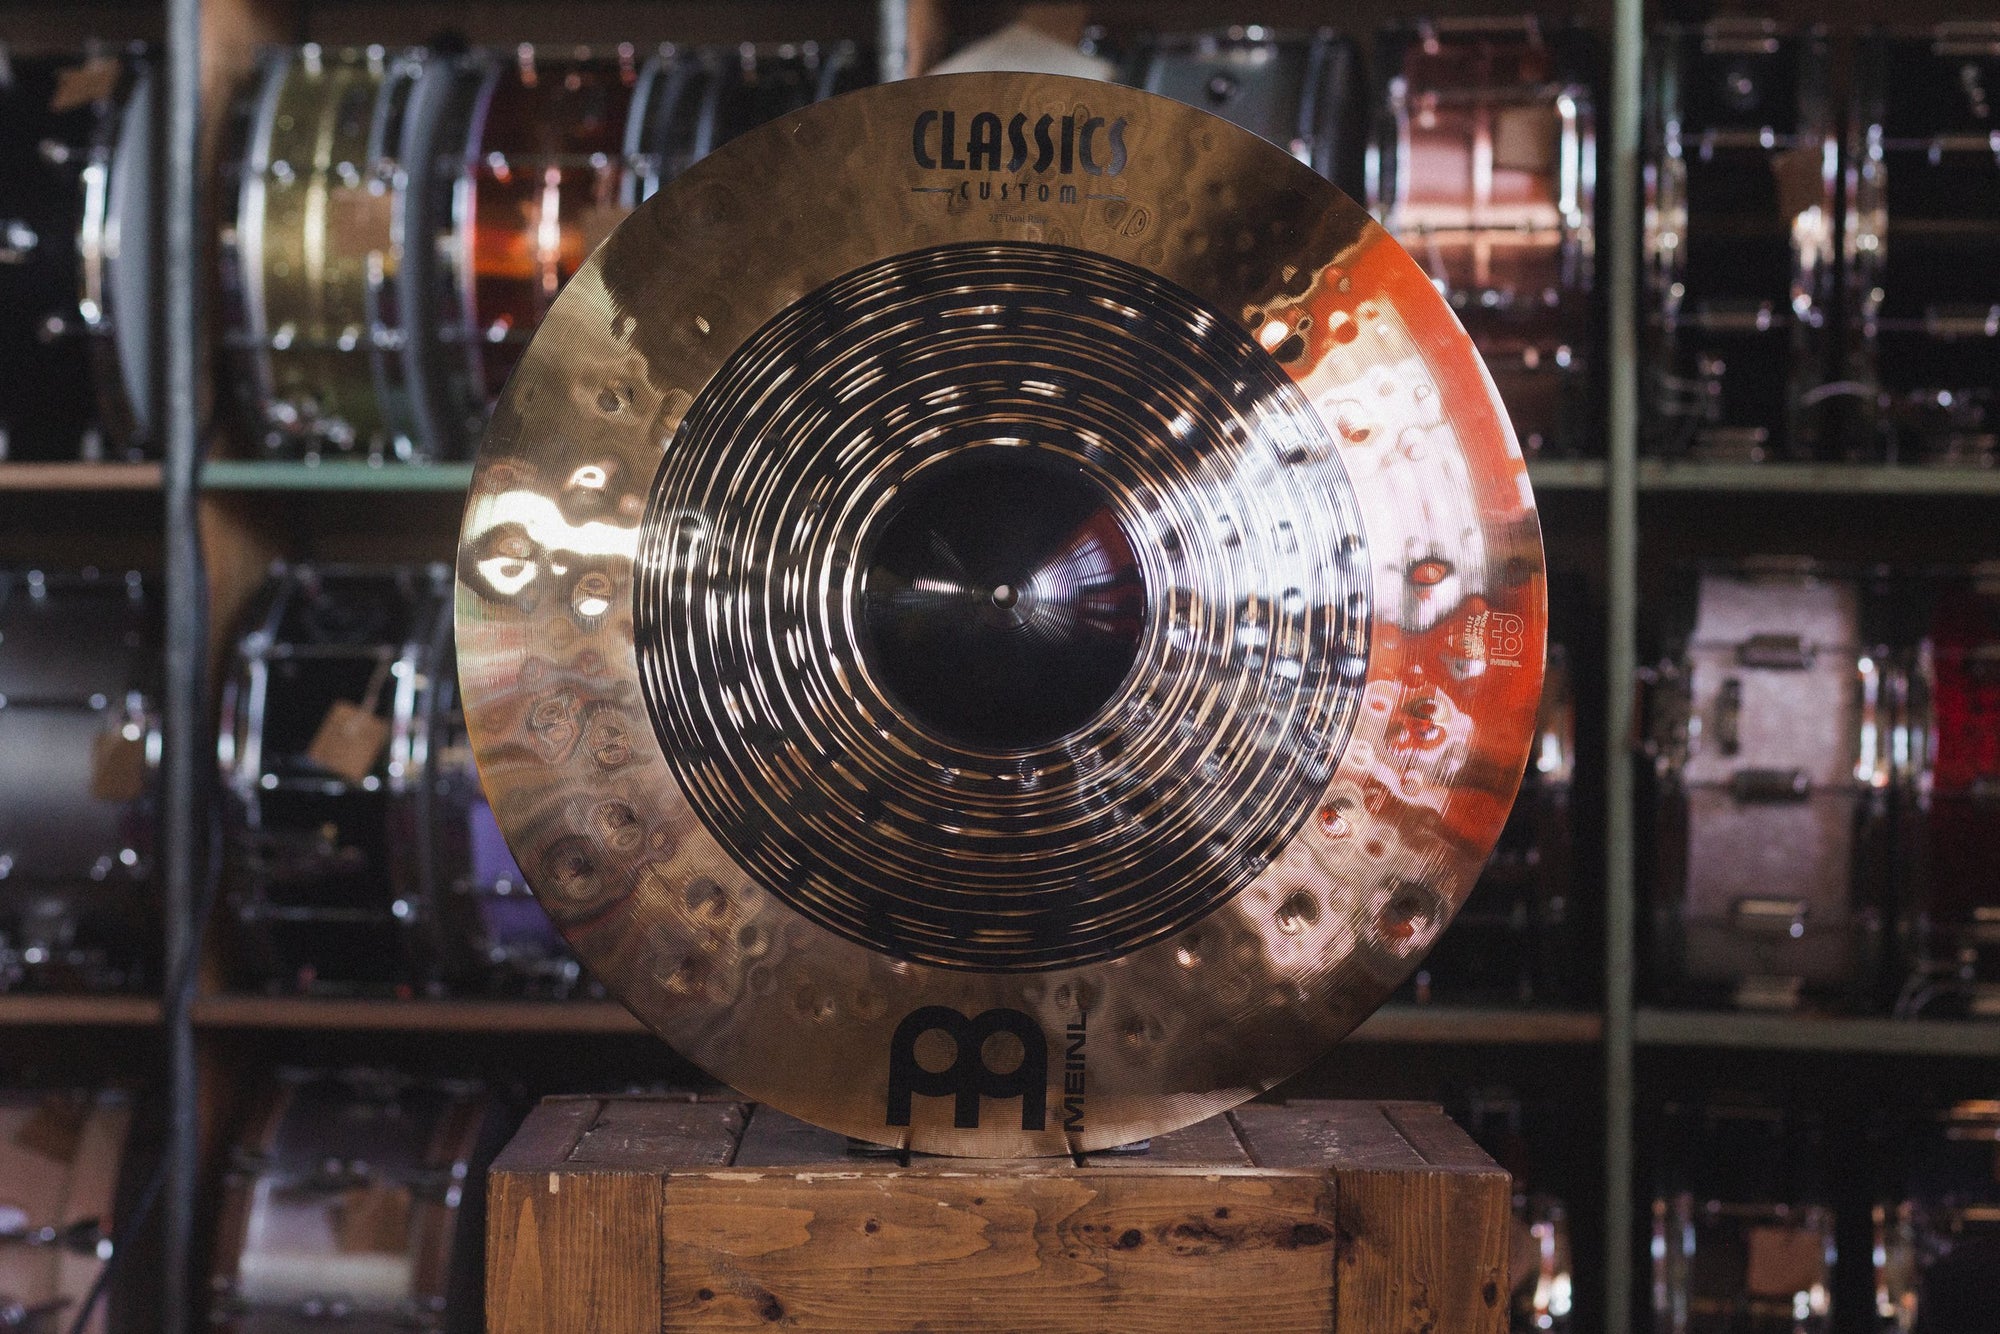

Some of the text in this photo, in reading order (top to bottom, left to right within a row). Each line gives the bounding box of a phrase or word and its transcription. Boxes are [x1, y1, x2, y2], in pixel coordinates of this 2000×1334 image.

[912, 110, 1127, 177] CLASSICS
[960, 181, 1076, 204] CUSTOM
[1063, 1011, 1087, 1132] MEINL
